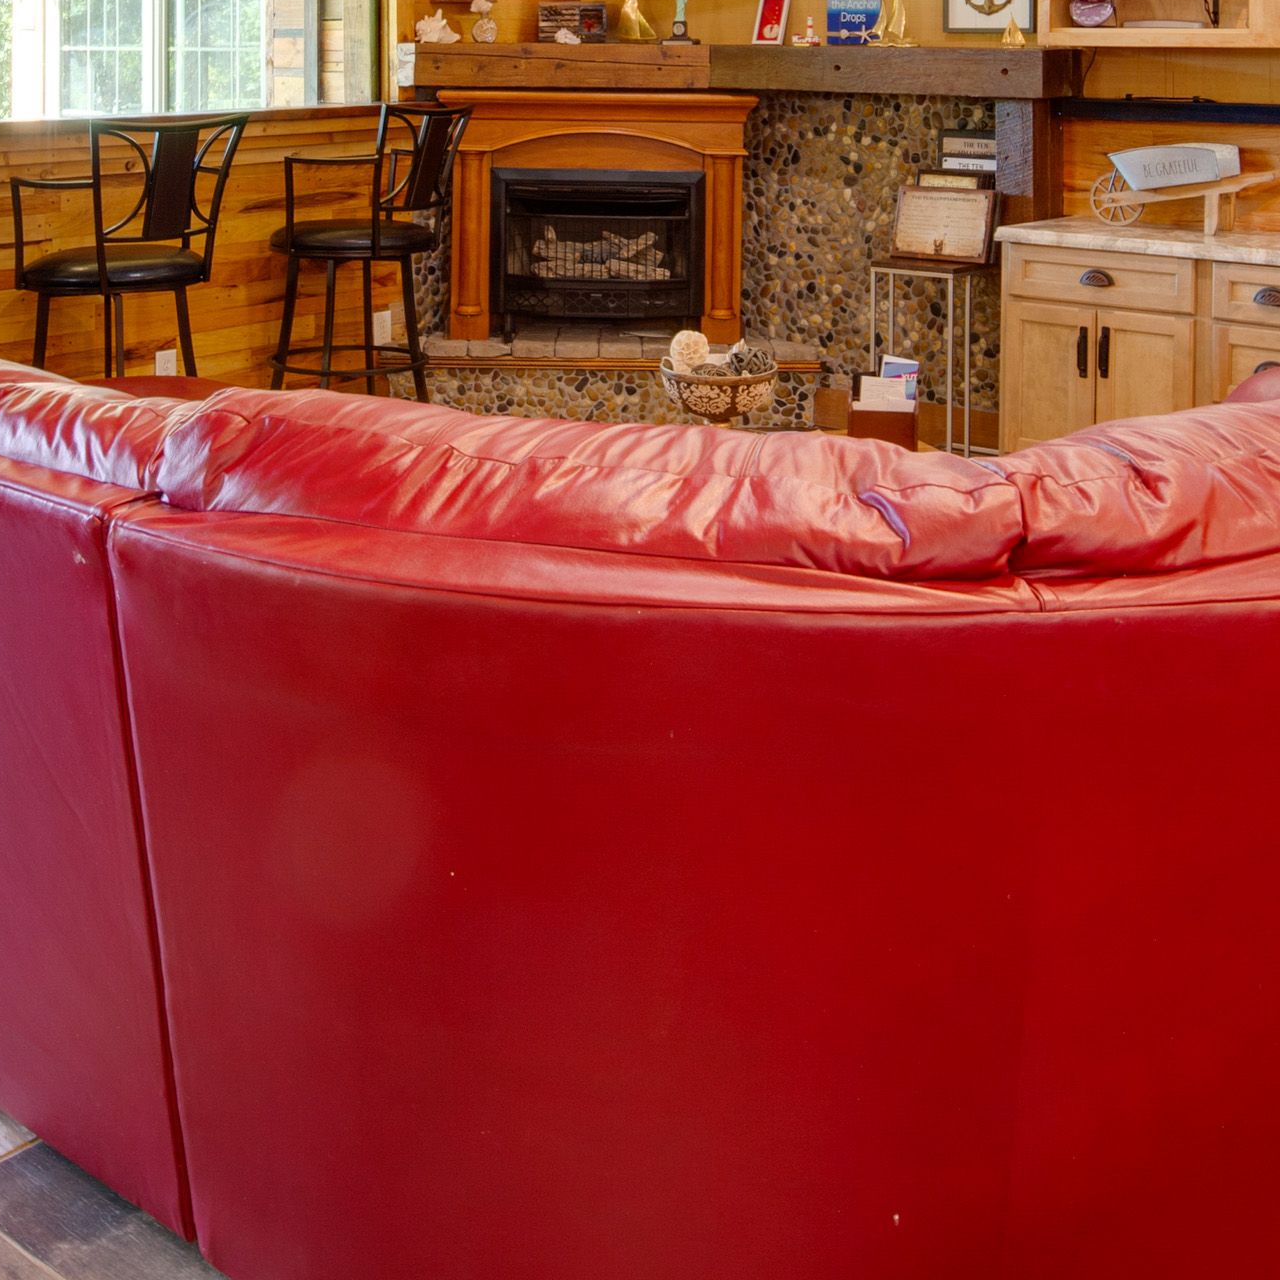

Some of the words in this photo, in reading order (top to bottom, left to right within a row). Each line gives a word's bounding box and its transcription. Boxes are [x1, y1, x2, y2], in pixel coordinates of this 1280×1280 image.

[831, 0, 846, 10] the
[847, 0, 877, 10] Anchor
[840, 12, 866, 24] Drops
[1143, 163, 1154, 178] BE
[1155, 158, 1200, 177] GRATEFUL
